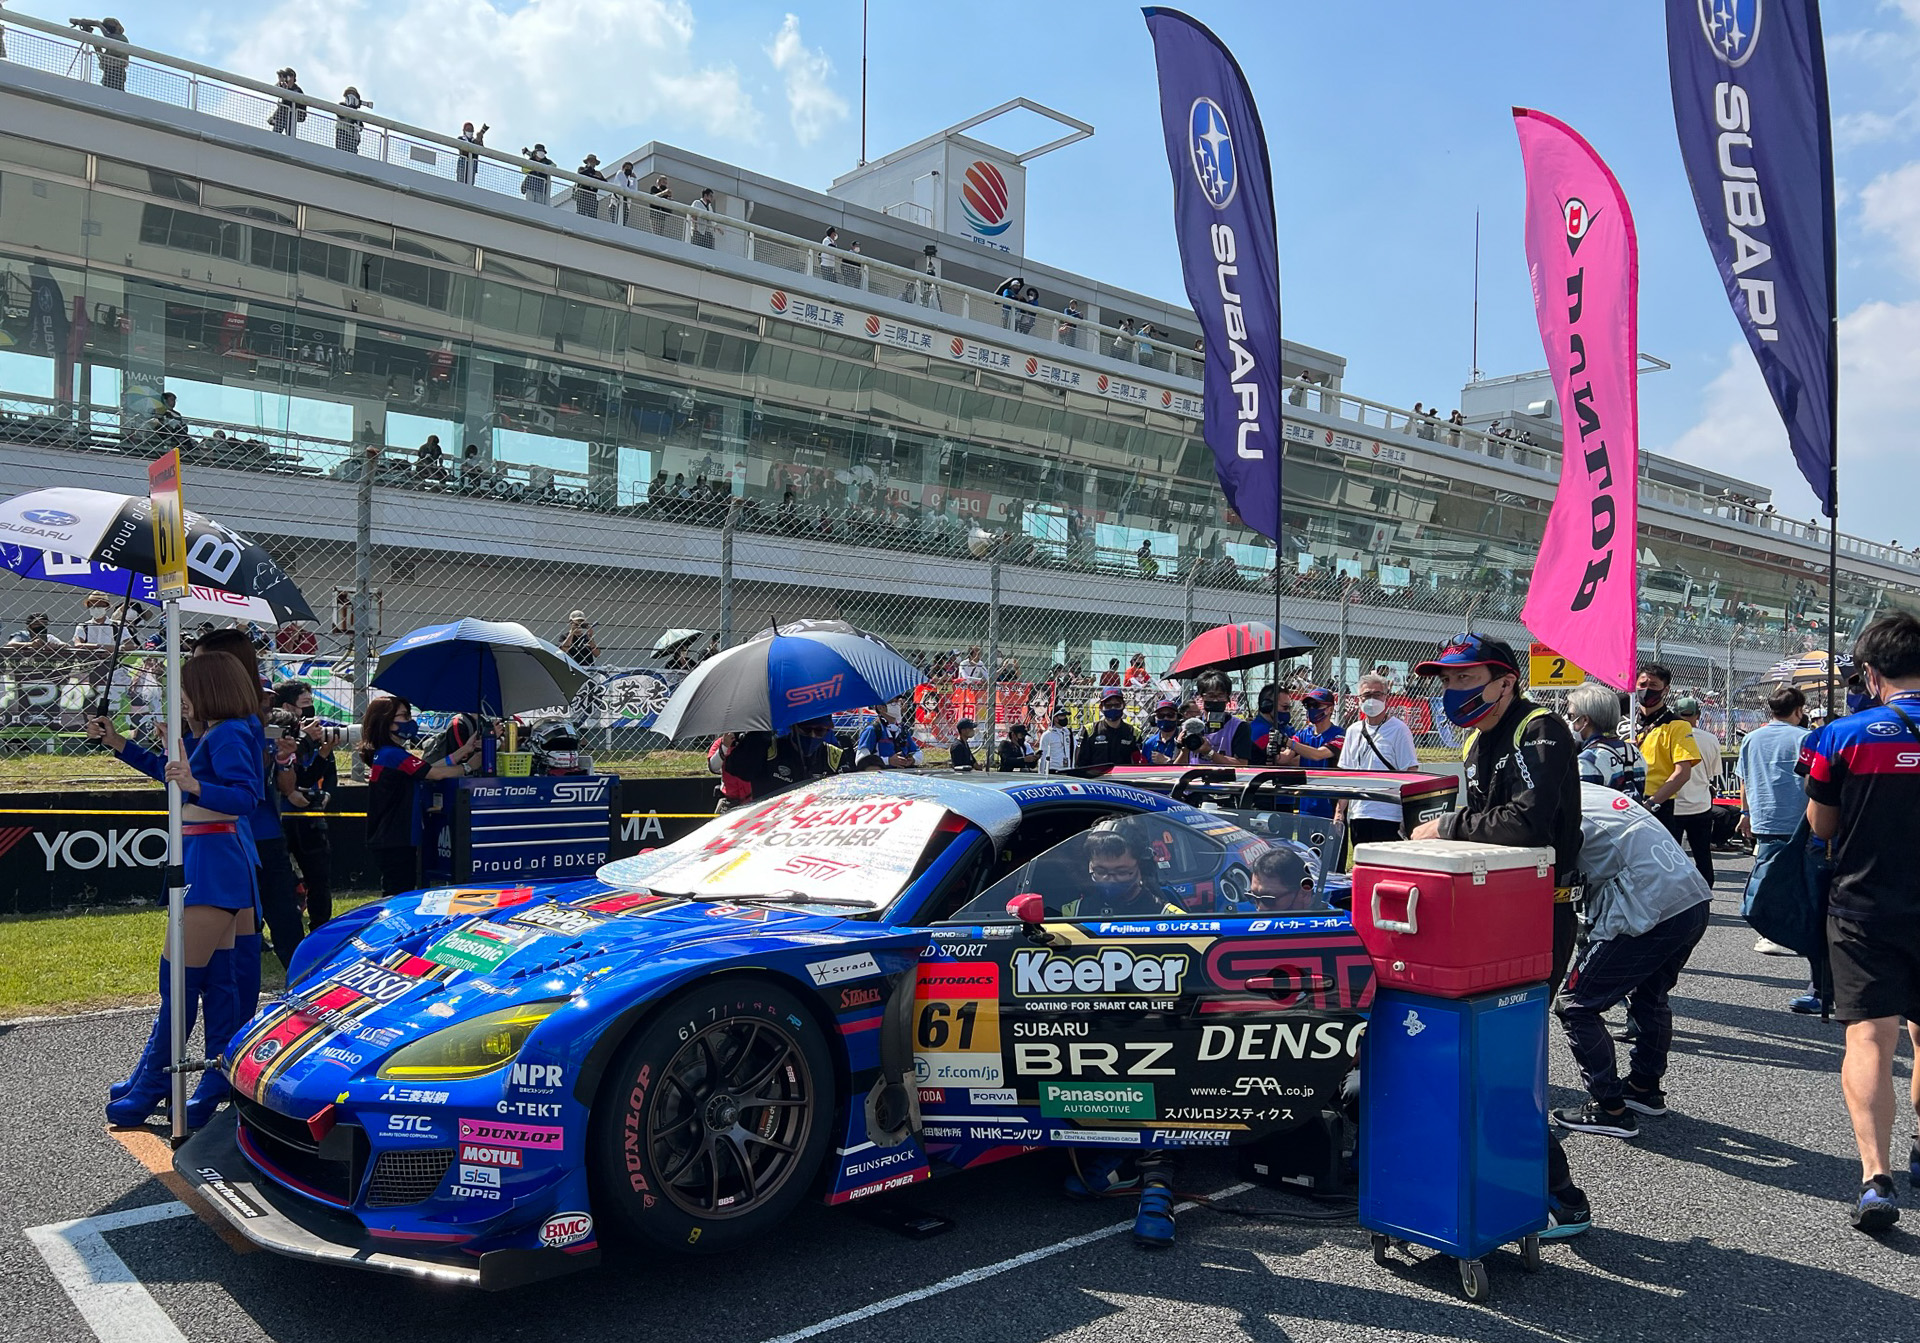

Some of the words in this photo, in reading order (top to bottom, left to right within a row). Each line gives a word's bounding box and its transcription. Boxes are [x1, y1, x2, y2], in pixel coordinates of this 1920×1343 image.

[791, 300, 845, 327] 三陽工業
[884, 324, 932, 348] 三陽工業
[1211, 223, 1264, 460] SUBARU
[967, 345, 1011, 368] 三陽工業
[1041, 364, 1081, 386] 三陽工業
[0, 521, 73, 541] SUBARU
[100, 520, 136, 561] Proud
[158, 500, 175, 565] 61
[1550, 658, 1566, 678] 2
[473, 786, 502, 797] Mac
[504, 785, 537, 796] Tools
[1012, 785, 1065, 802] T.IGUCHI
[1086, 784, 1156, 806] H.YAMAUCHI
[788, 802, 914, 830] HEARTS
[764, 827, 889, 847] OGETHER!
[33, 828, 169, 871] YOKO
[472, 857, 522, 872] Proud
[530, 856, 546, 869] of
[554, 852, 607, 866] BOXER
[516, 903, 607, 934] KeePer
[1170, 921, 1221, 932] しげる工業
[1111, 924, 1150, 934] Fujikura
[438, 934, 504, 961] Panasonic
[938, 944, 988, 957] SPORT
[434, 951, 478, 972] AUTOMOTIVE
[832, 960, 874, 975] Strada
[1013, 948, 1187, 994] KeePer
[331, 963, 413, 1000] DENSO
[917, 976, 994, 986] AUTOBACS
[840, 988, 881, 1008] STANLEY
[1026, 1002, 1068, 1012] COATING
[1071, 1002, 1090, 1011] FOR
[1093, 1002, 1126, 1011] SMART
[1128, 1001, 1149, 1010] CAR
[1152, 1001, 1174, 1010] LIFE
[1510, 992, 1528, 1006] SPORT
[318, 1008, 364, 1035] BOXER
[918, 1002, 978, 1050] 61
[1014, 1022, 1089, 1037] SUBARU
[320, 1046, 362, 1064] MIZUHO
[1014, 1042, 1176, 1076] BRZ
[512, 1062, 563, 1087] NPR
[786, 1066, 796, 1082] BBS
[938, 1064, 999, 1080] zf.com/jp
[1047, 1086, 1144, 1104] Panasonic
[496, 1100, 562, 1118] G-TEKT
[1063, 1105, 1131, 1114] AUTOMOTIVE
[1164, 1107, 1294, 1120] スバルロジスティクス
[388, 1114, 432, 1132] STC
[624, 1064, 651, 1193] DUNLOP
[922, 1128, 962, 1138] 田製作所
[476, 1126, 560, 1144] DUNLOP
[970, 1128, 1001, 1139] NHK
[1001, 1129, 1042, 1140] ニッパツ
[1152, 1130, 1231, 1143] FUJIKIKAI
[462, 1146, 520, 1166] MOTUL
[846, 1150, 915, 1176] GUNSROCK
[850, 1183, 882, 1200] IRIDIUM
[884, 1174, 914, 1190] POWER
[718, 1196, 734, 1206] BBS
[545, 1218, 588, 1238] BMC
